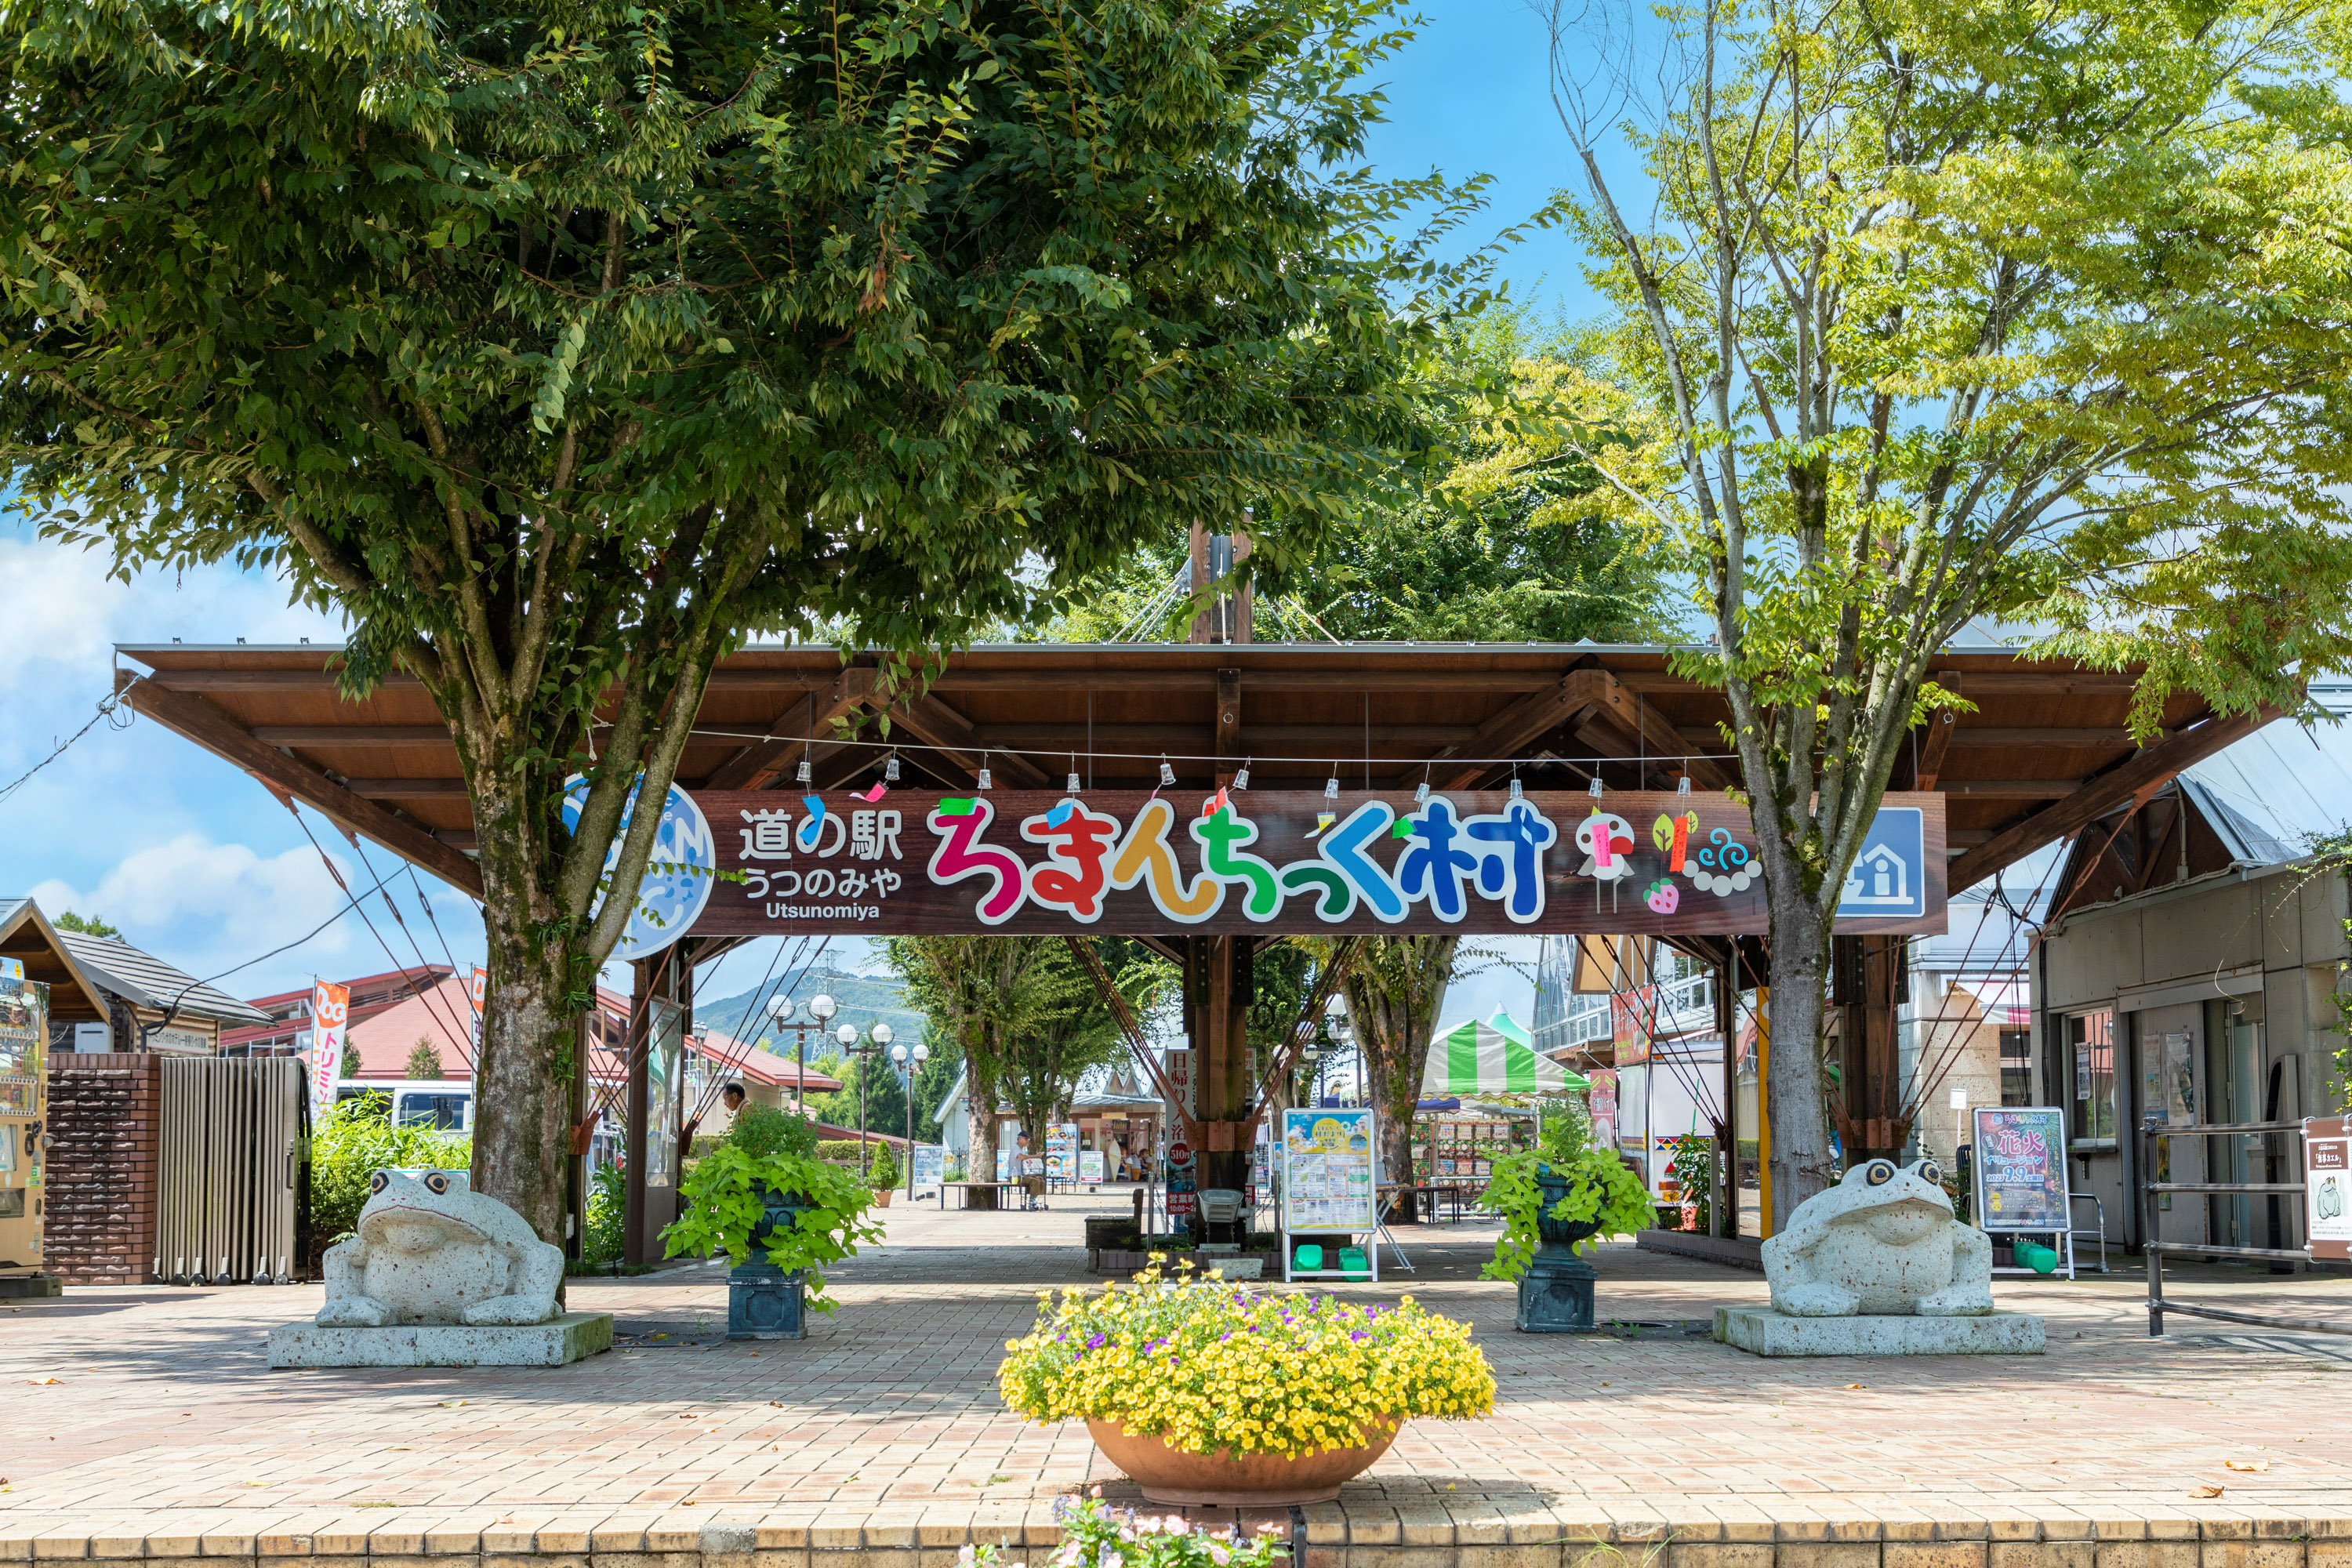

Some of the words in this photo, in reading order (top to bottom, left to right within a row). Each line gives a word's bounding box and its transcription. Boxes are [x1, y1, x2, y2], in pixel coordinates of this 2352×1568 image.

[739, 808, 903, 861] 道の駅
[927, 795, 1557, 924] ろまんちっく村
[746, 868, 902, 898] うつのみや
[766, 902, 880, 921] Utsunomiya
[316, 985, 347, 1022] DOG
[1170, 1149, 1190, 1160] 510円
[1996, 1130, 2044, 1155] 花火
[1984, 1155, 2044, 1167] イリュージョン
[1986, 1174, 2005, 1182] 2023
[2002, 1166, 2028, 1182] 9.9
